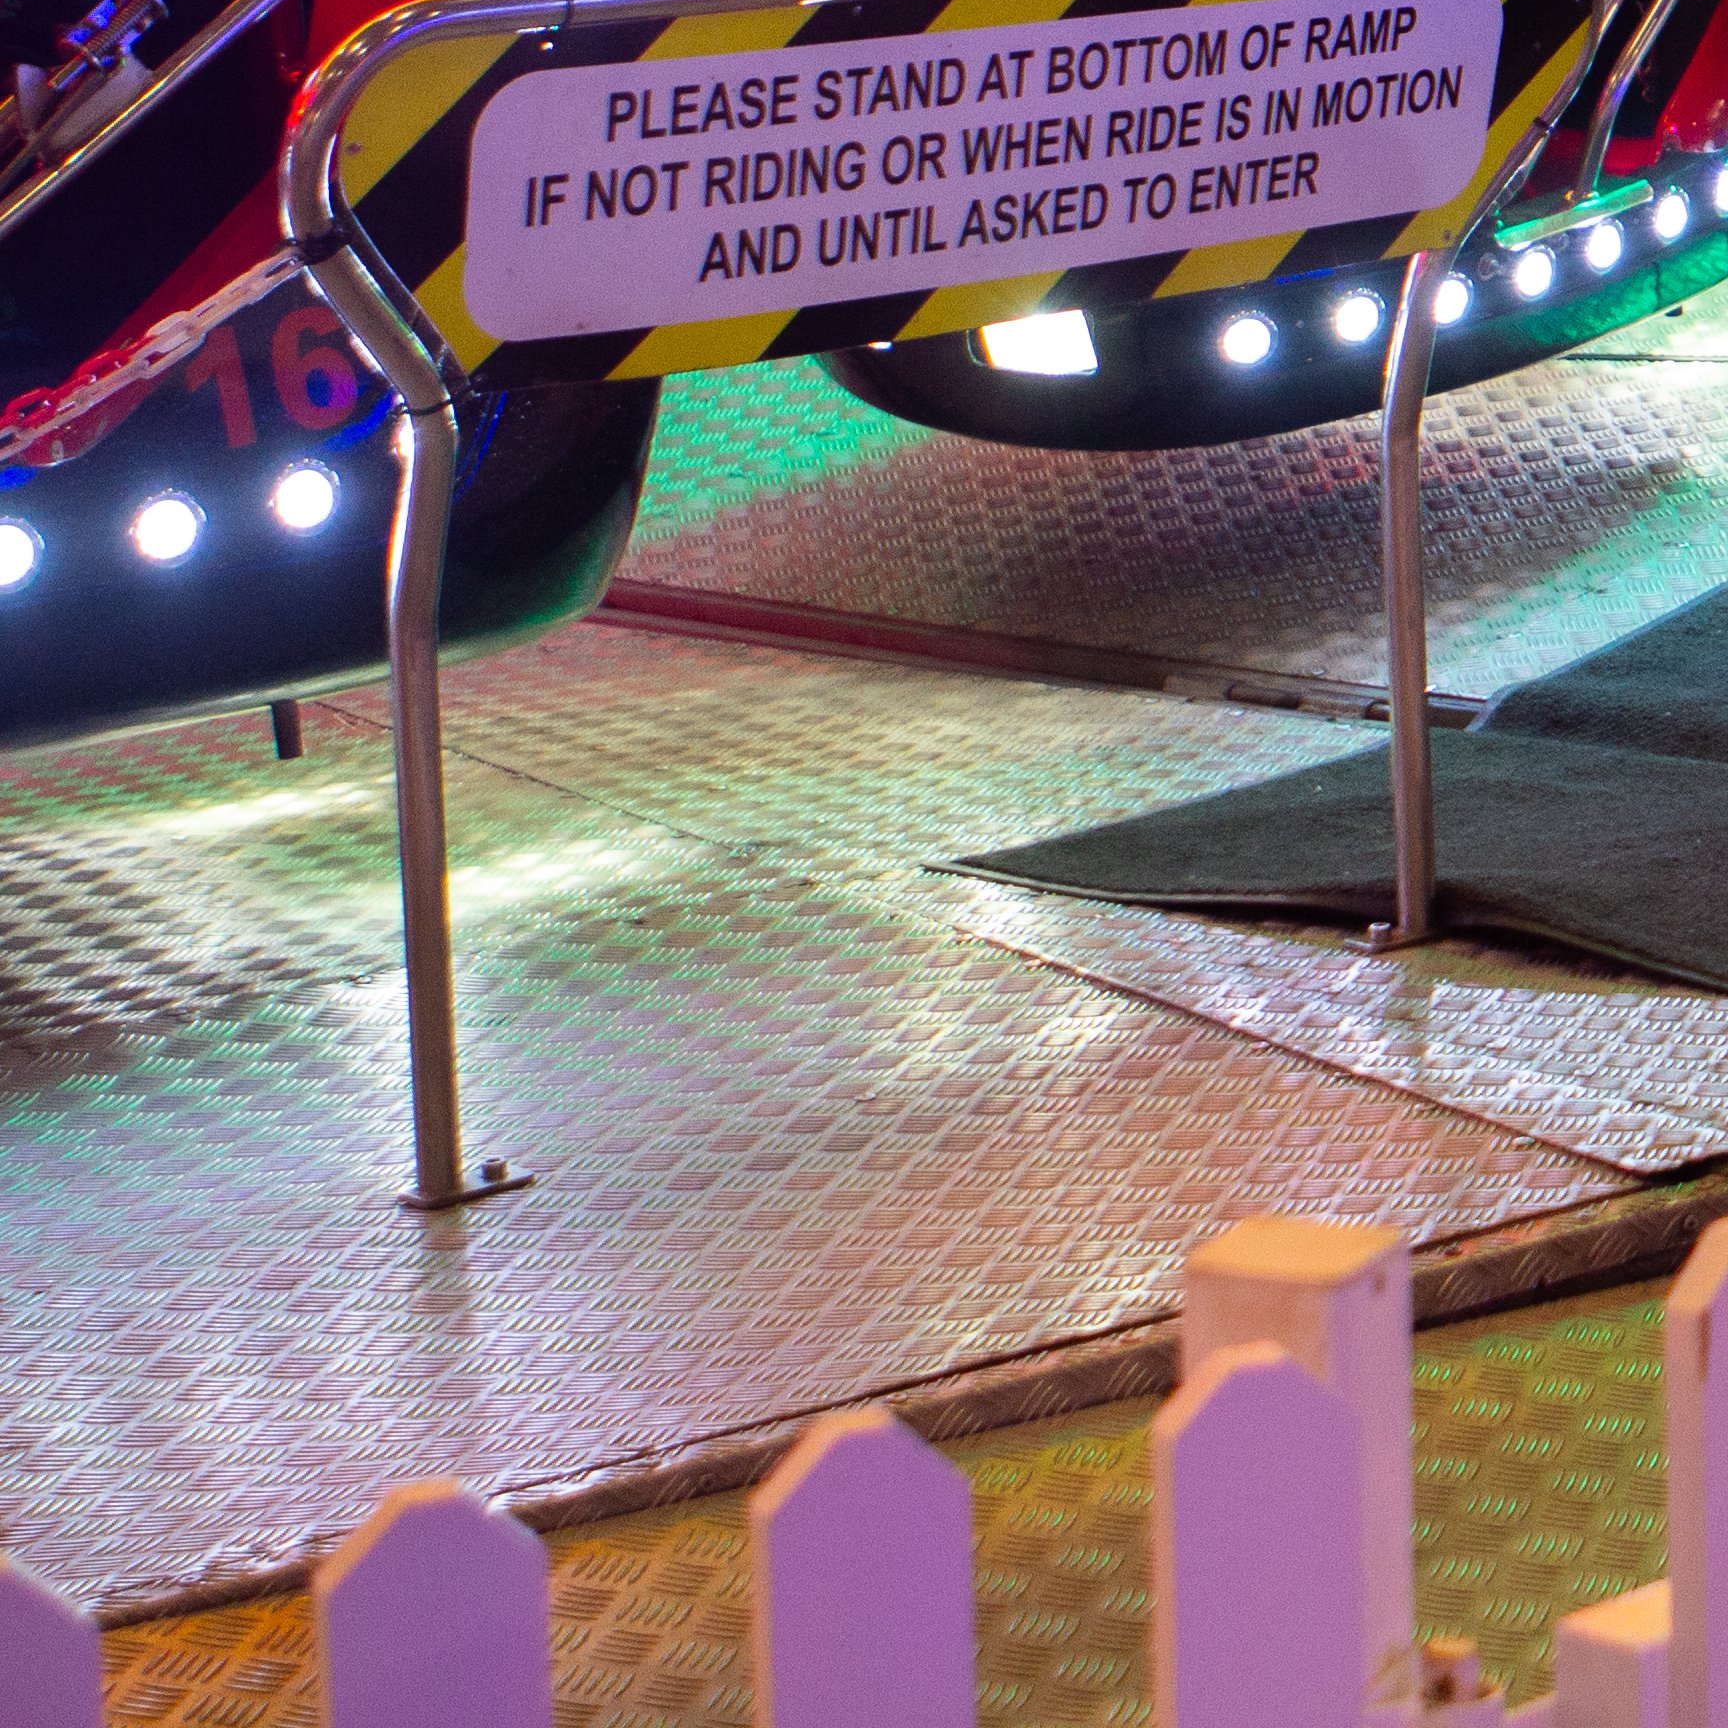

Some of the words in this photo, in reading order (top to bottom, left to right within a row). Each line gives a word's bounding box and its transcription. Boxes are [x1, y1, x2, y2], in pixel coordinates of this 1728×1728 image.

[607, 74, 800, 142] PLEASE
[814, 57, 967, 120] STAND
[977, 49, 1034, 103] AT
[1046, 30, 1228, 94] BOTTOM
[1240, 21, 1295, 71] OF
[1305, 6, 1417, 63] RAMP
[525, 174, 569, 228] IF
[585, 161, 691, 221] NOT
[704, 141, 866, 207] RIDING
[882, 132, 947, 185] OR
[963, 114, 1093, 175] WHEN
[1106, 101, 1205, 158] RIDE
[1215, 94, 1252, 143] IS
[1263, 87, 1302, 135] IN
[1312, 65, 1464, 127] MOTION
[699, 223, 801, 283] AND
[818, 206, 947, 267] UNTIL
[958, 183, 1108, 247] ASKED
[1123, 173, 1177, 223] TO
[1188, 151, 1320, 213] ENTER
[185, 305, 358, 449] 16
